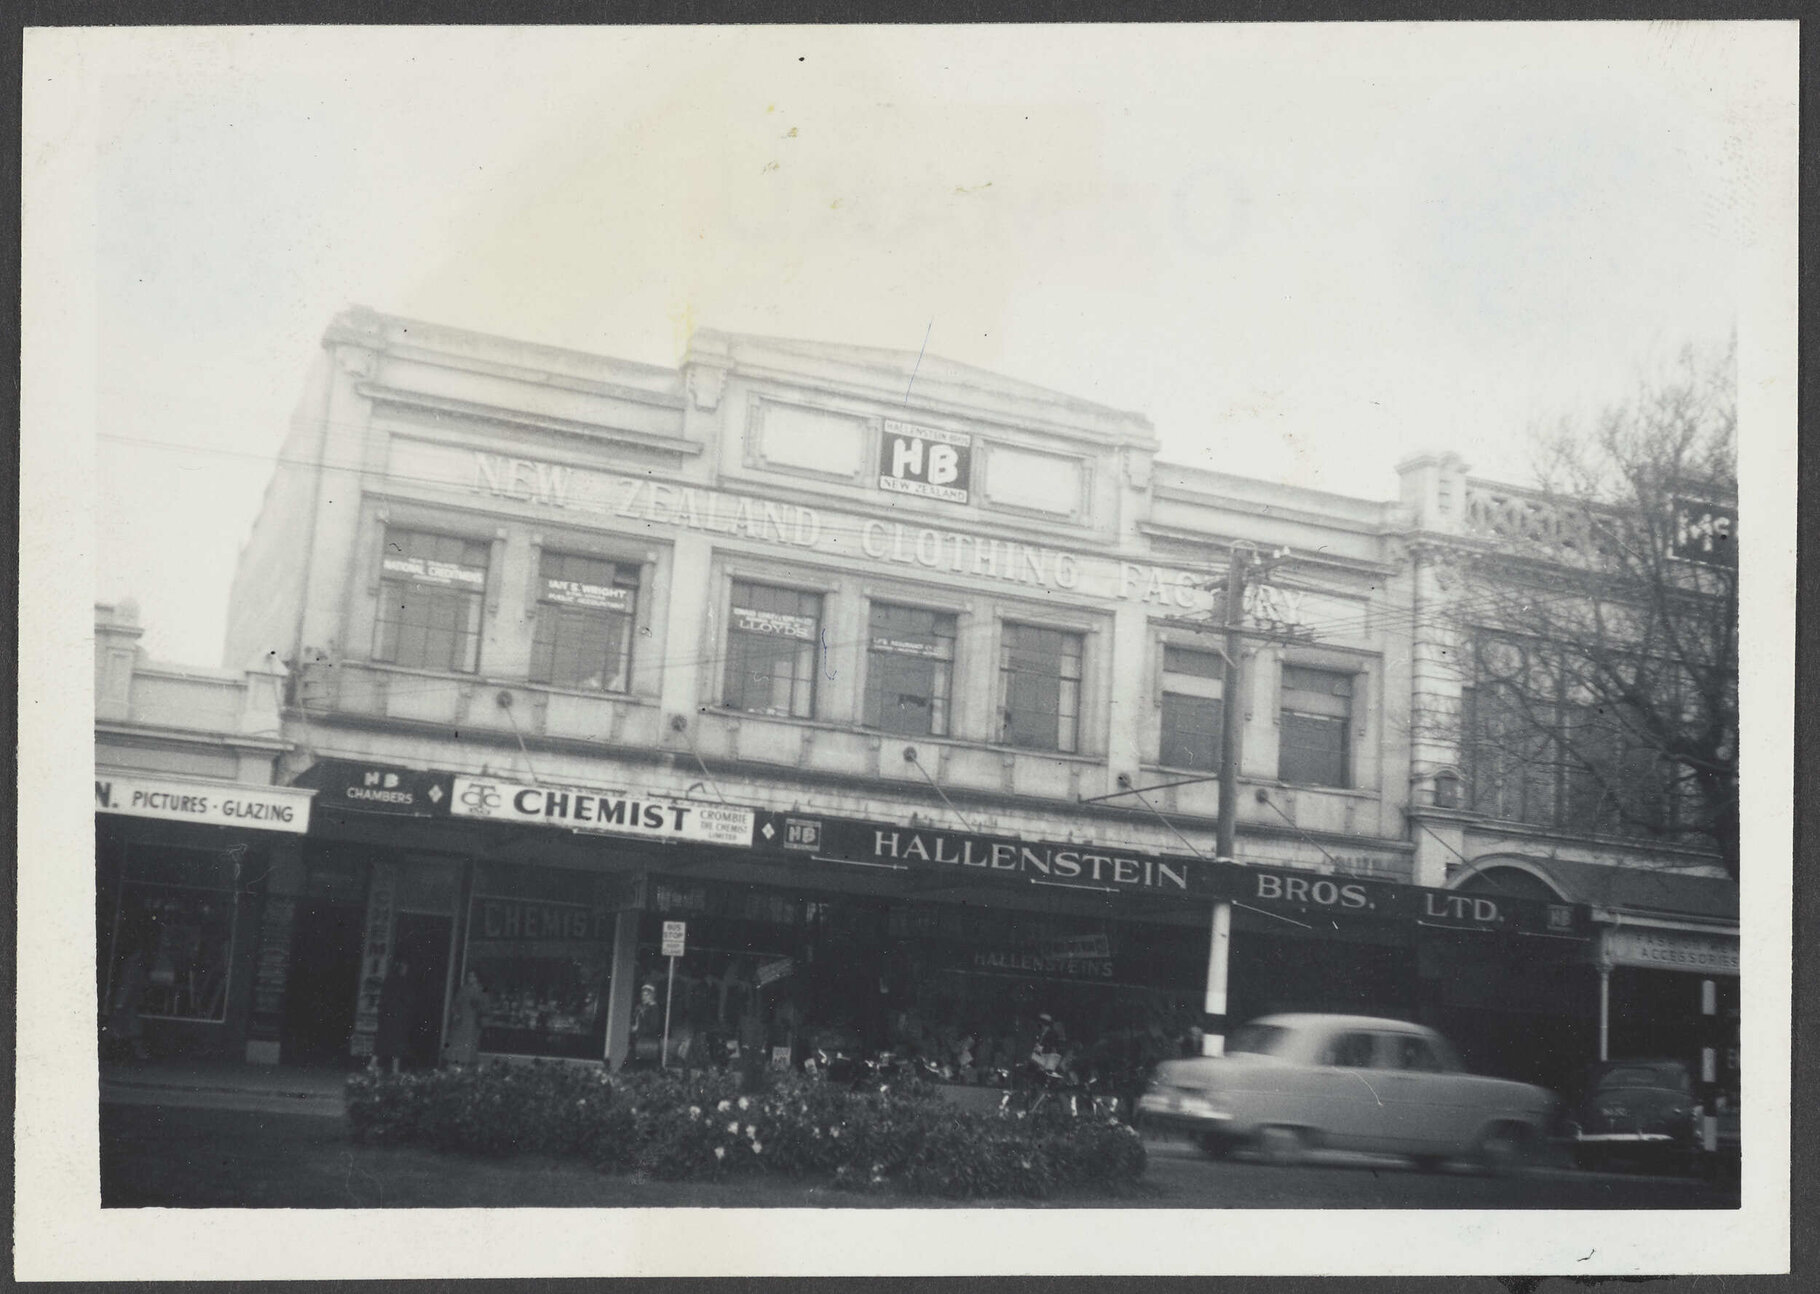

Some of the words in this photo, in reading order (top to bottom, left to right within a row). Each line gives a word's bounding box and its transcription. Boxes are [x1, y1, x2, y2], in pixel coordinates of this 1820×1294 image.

[886, 421, 947, 440] HALLENSTEIN
[893, 438, 959, 485] HB
[883, 478, 910, 491] NEW
[915, 484, 966, 502] ZEALAND
[470, 452, 573, 508] NEW
[615, 479, 820, 548] ZEALAND
[861, 519, 1078, 590] CLOTHING
[739, 619, 808, 638] LLOYDS
[346, 786, 413, 804] CHAMBERS
[132, 791, 208, 814] PICTURES
[222, 800, 294, 823] GLAZING
[513, 789, 692, 831] CHEMIST
[700, 809, 747, 824] CROMBIE
[700, 820, 713, 830] THE
[715, 823, 748, 833] CHEMIST
[789, 825, 816, 844] HB
[874, 830, 1188, 890] HALLENSTEIN
[1257, 873, 1376, 910] BROS.
[1426, 893, 1505, 922] LTD.
[664, 931, 683, 939] STOP
[666, 923, 681, 931] BUS
